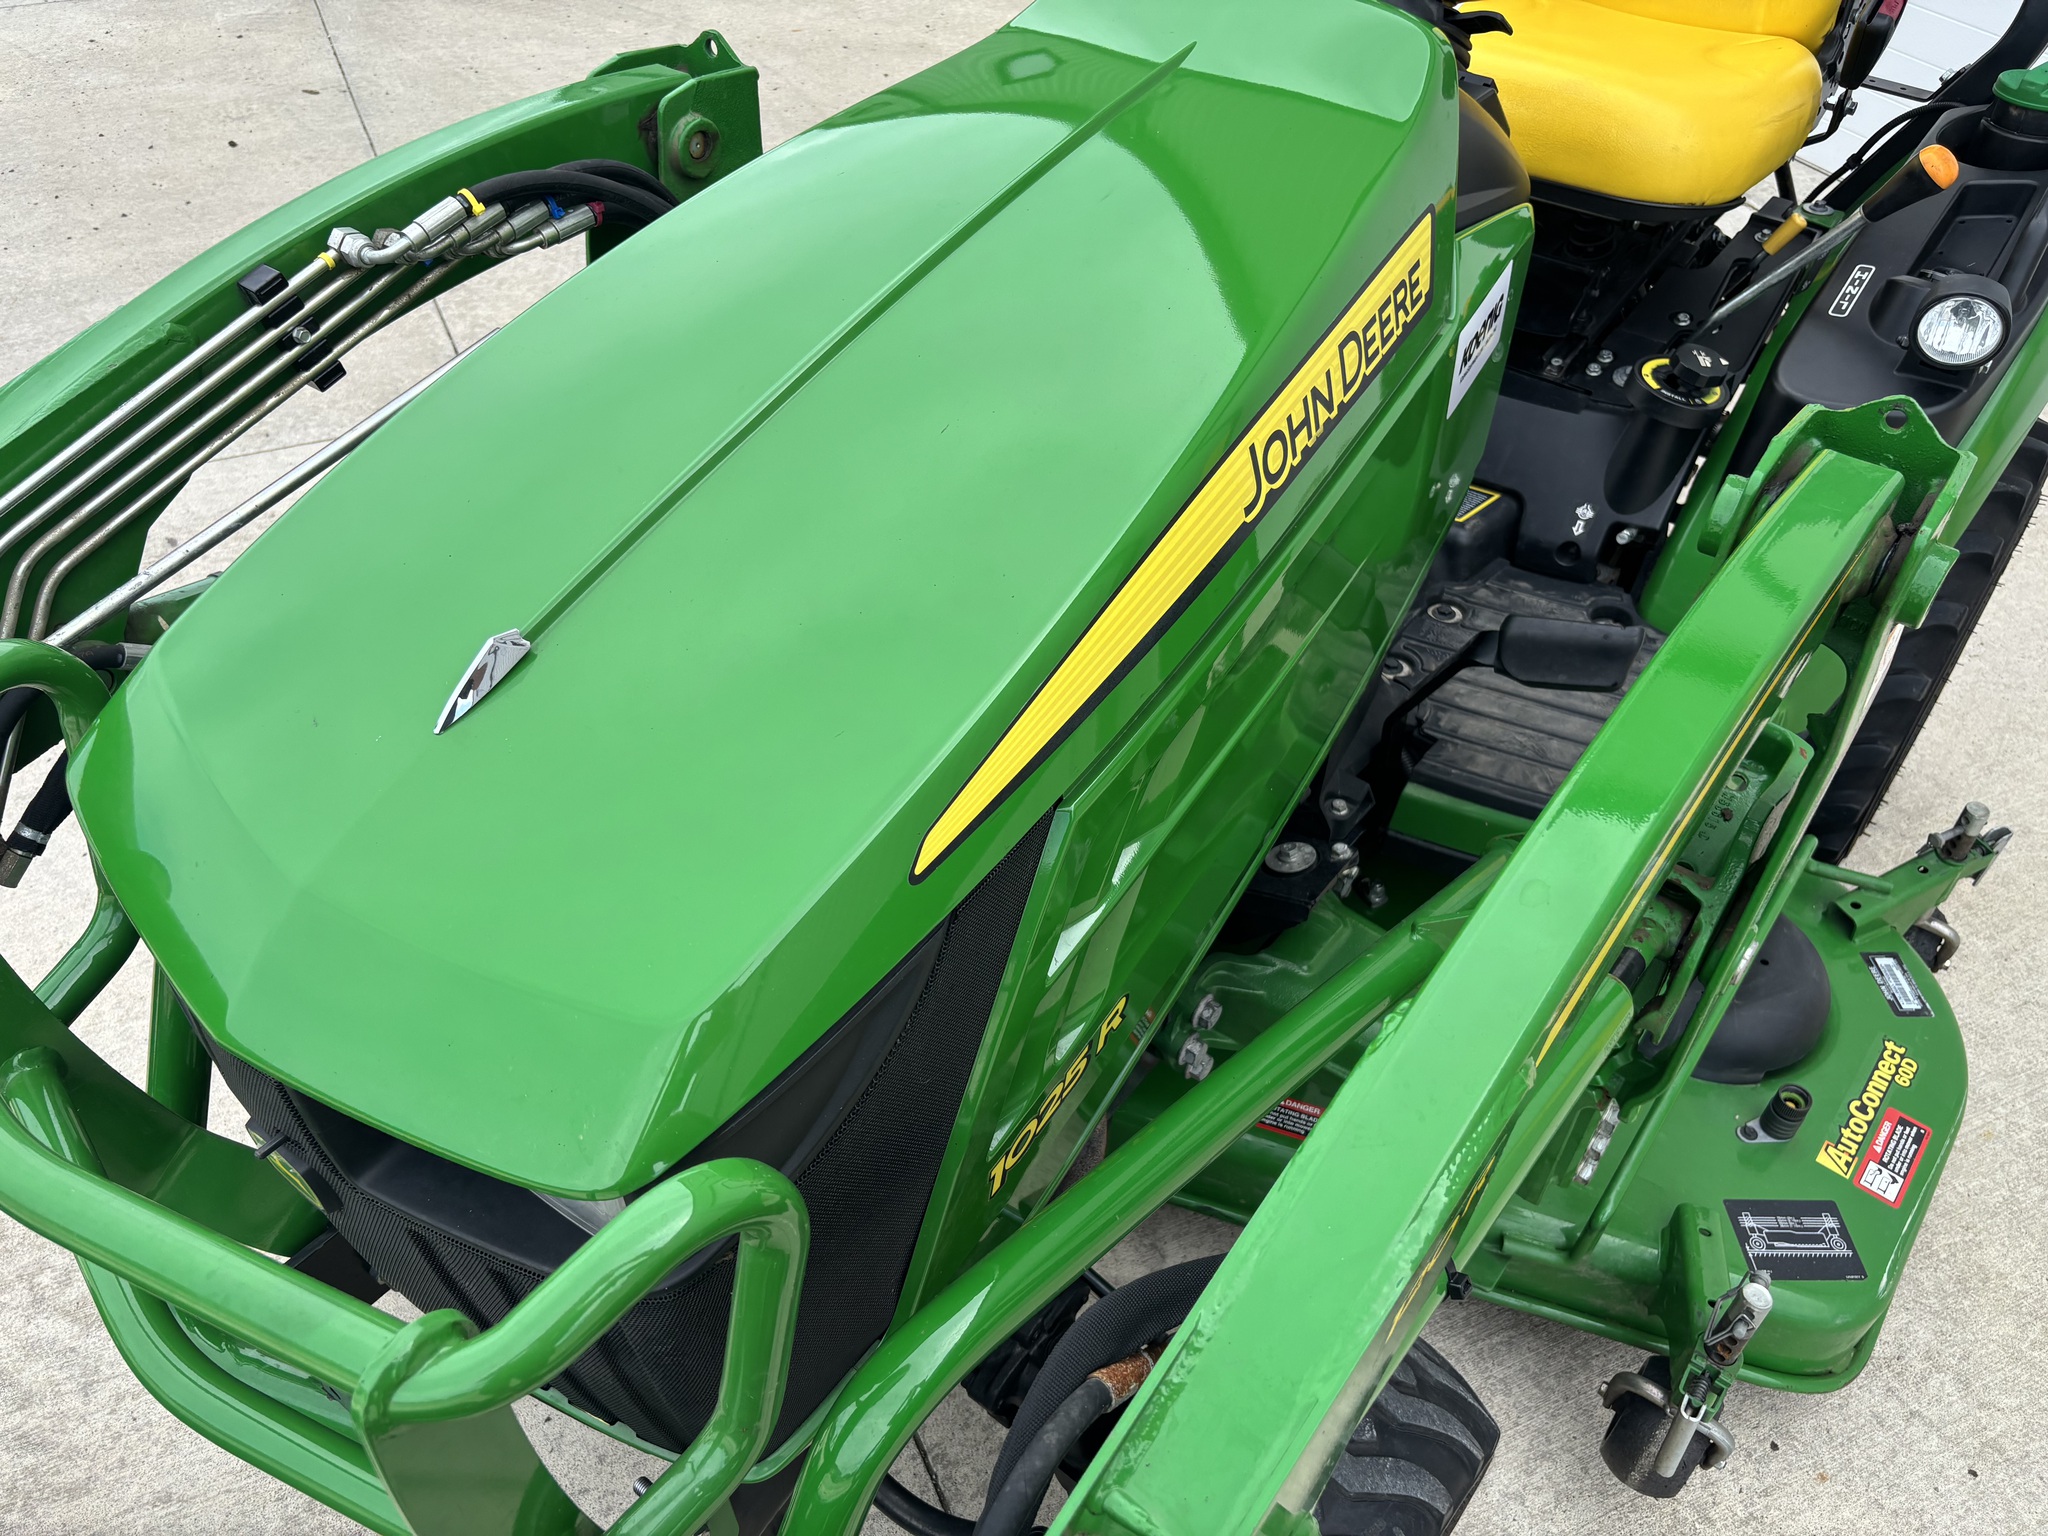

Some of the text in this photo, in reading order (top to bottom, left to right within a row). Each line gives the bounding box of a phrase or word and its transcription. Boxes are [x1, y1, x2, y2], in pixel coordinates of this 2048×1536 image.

[1243, 258, 1424, 518] JOHN DEERE
[1894, 1057, 1918, 1087] 60D
[1285, 1099, 1321, 1115] DANGER
[1300, 1113, 1318, 1122] BLAD
[1826, 1039, 1906, 1174] AutoConnect
[1878, 1121, 1892, 1146] DANGER
